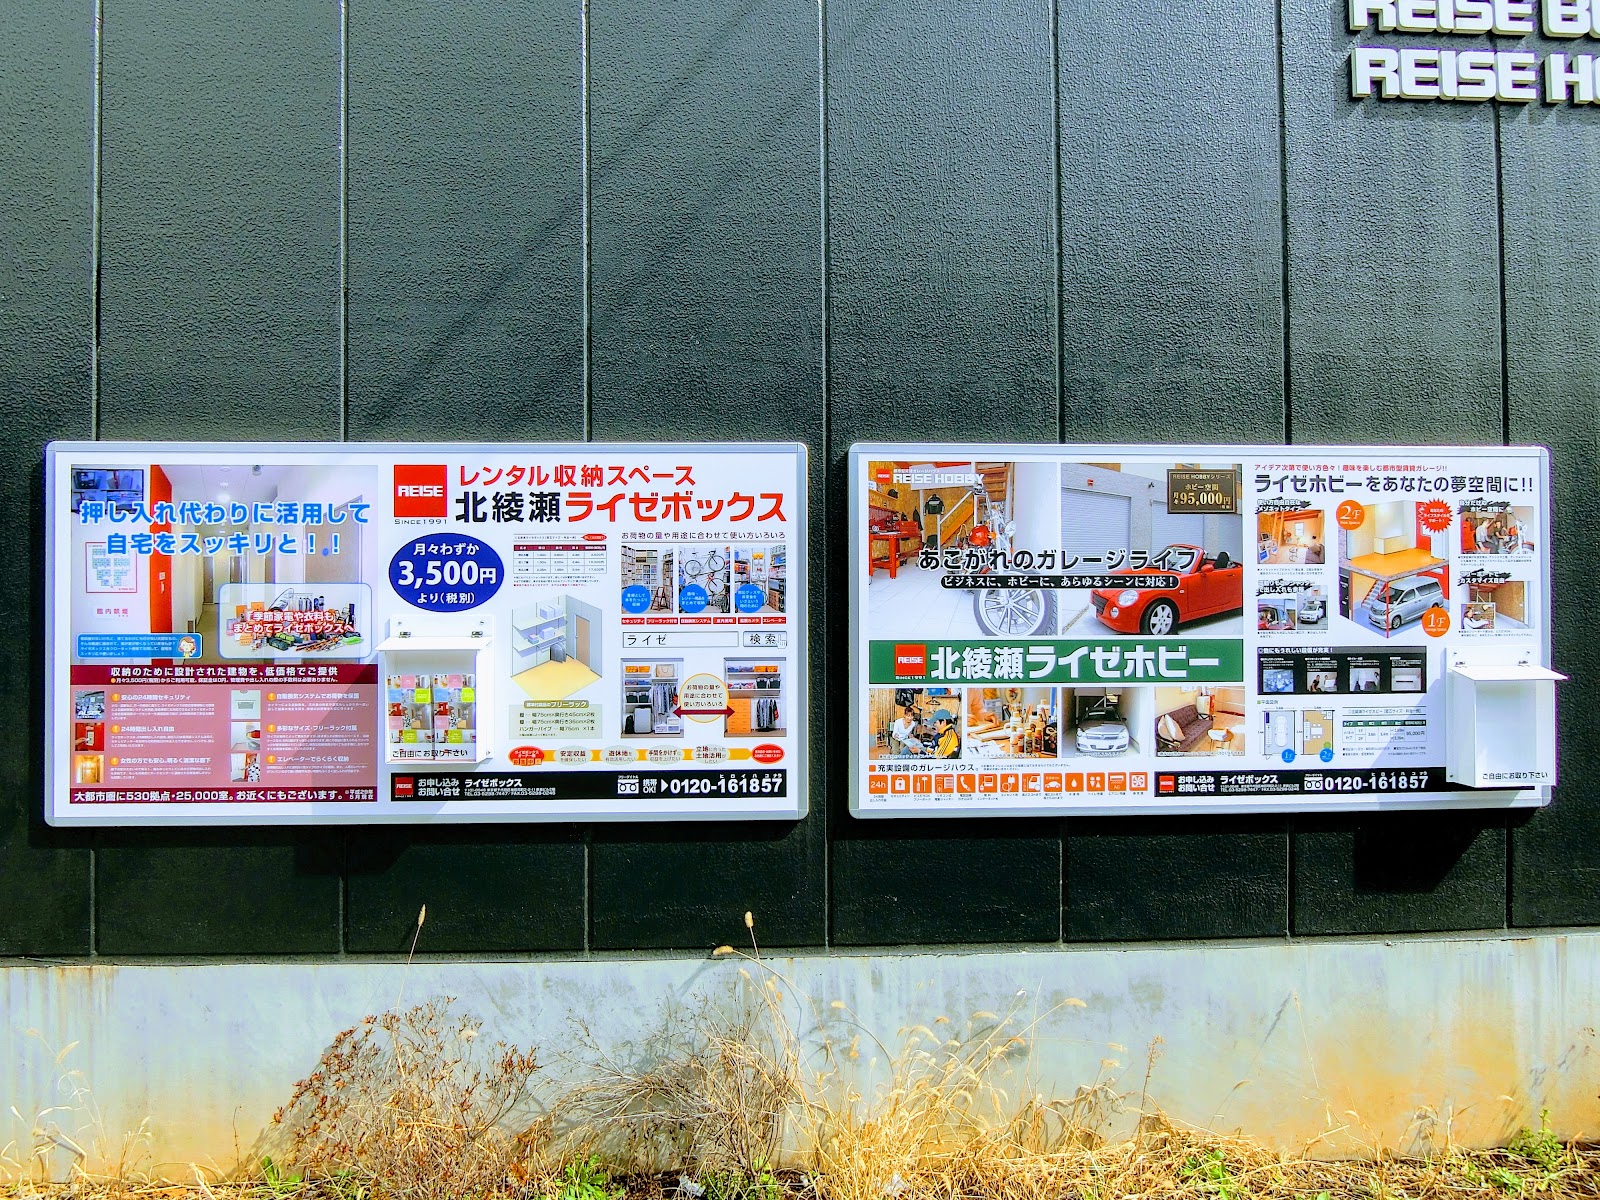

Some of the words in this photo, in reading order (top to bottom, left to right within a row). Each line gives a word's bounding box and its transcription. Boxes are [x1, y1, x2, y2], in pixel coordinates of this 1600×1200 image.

[1543, 0, 1600, 38] B
[1351, 47, 1538, 102] REISE
[1545, 52, 1600, 105] H
[460, 464, 696, 487] レンタル収納スペース
[893, 473, 932, 484] REISE
[935, 473, 985, 484] HOBBY
[1254, 474, 1533, 493] ライゼホビーをあなたの夢空間に!!
[397, 485, 444, 497] REISE
[1179, 492, 1231, 506] 95,000円
[80, 501, 371, 525] 押し入れ代わりに活用して
[455, 491, 787, 523] 北綾瀬ライゼボックス
[1340, 505, 1362, 520] 2F
[621, 531, 786, 540] お荷物の量や用途に合わせて使い方いろいろ
[413, 543, 480, 556] 月々わずか
[918, 549, 1196, 571] あこがれのガレージライフ
[397, 559, 497, 590] 3,500円
[1427, 613, 1446, 628] 1F
[233, 623, 354, 634] まとめてライゼボックスへ
[627, 634, 667, 646] ライゼ
[749, 633, 776, 645] 検索
[897, 656, 924, 664] REISE
[930, 644, 1220, 680] 北綾瀬ライゼホビー
[110, 666, 339, 677] 収納のために設計された建物を、低価格でご提供
[392, 749, 468, 758] ご自由にお取り下さい
[1177, 775, 1215, 784] お申し込み
[1220, 774, 1279, 784] ライゼボックス
[1482, 771, 1548, 780] ご自由にお取り下さい
[417, 778, 459, 787] お申し込み
[464, 778, 523, 788] ライゼボックス
[670, 777, 783, 794] 0120-161857
[1178, 784, 1215, 792] お問い合せ
[1324, 775, 1429, 791] 0120-161857
[417, 787, 460, 797] お問い合せ
